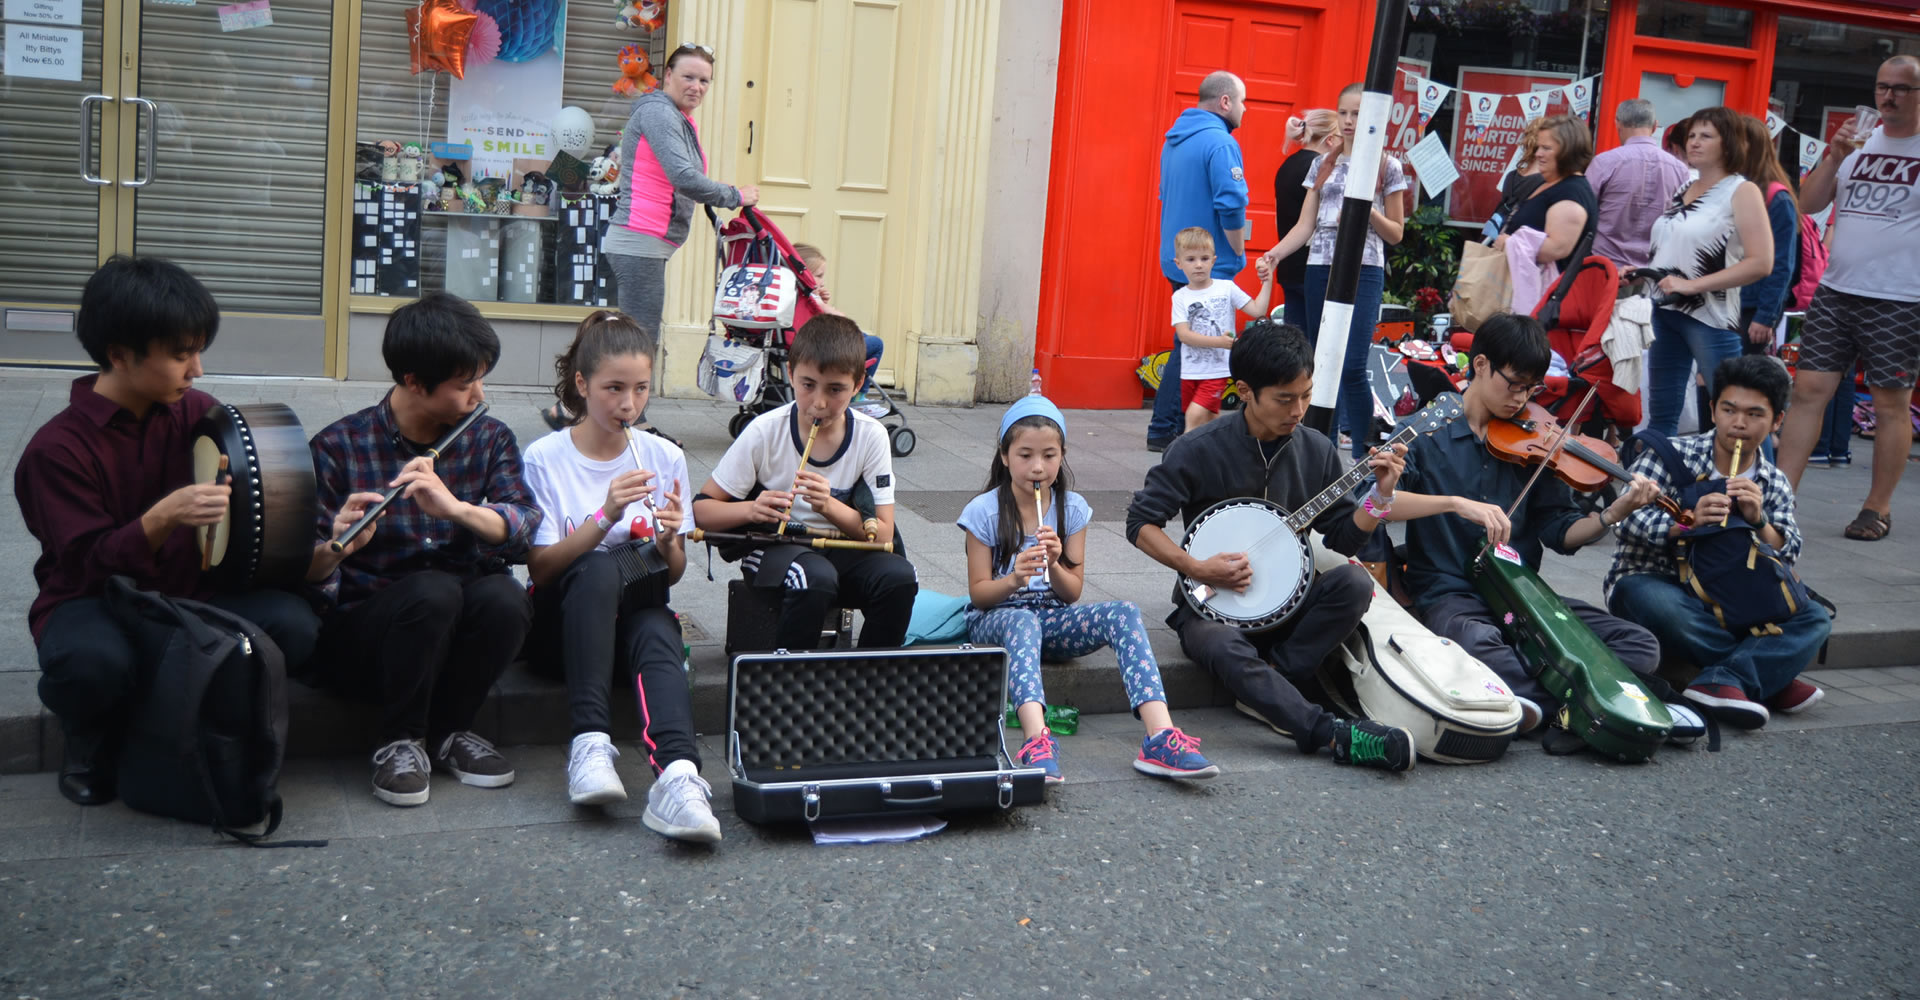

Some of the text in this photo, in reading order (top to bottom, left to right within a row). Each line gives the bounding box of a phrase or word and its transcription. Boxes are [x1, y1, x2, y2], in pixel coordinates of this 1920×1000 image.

[34, 3, 53, 11] Gifting
[32, 33, 68, 43] Miniature
[26, 45, 61, 55] Itty Bittys
[22, 56, 64, 66] Now €5.00
[1465, 112, 1528, 129] BNGIN
[487, 126, 525, 137] SEND
[483, 140, 545, 155] SMILE
[1462, 143, 1507, 159] HOME
[1460, 159, 1498, 173] SINCE
[1852, 156, 1920, 182] MCK
[1844, 182, 1910, 212] 1992
